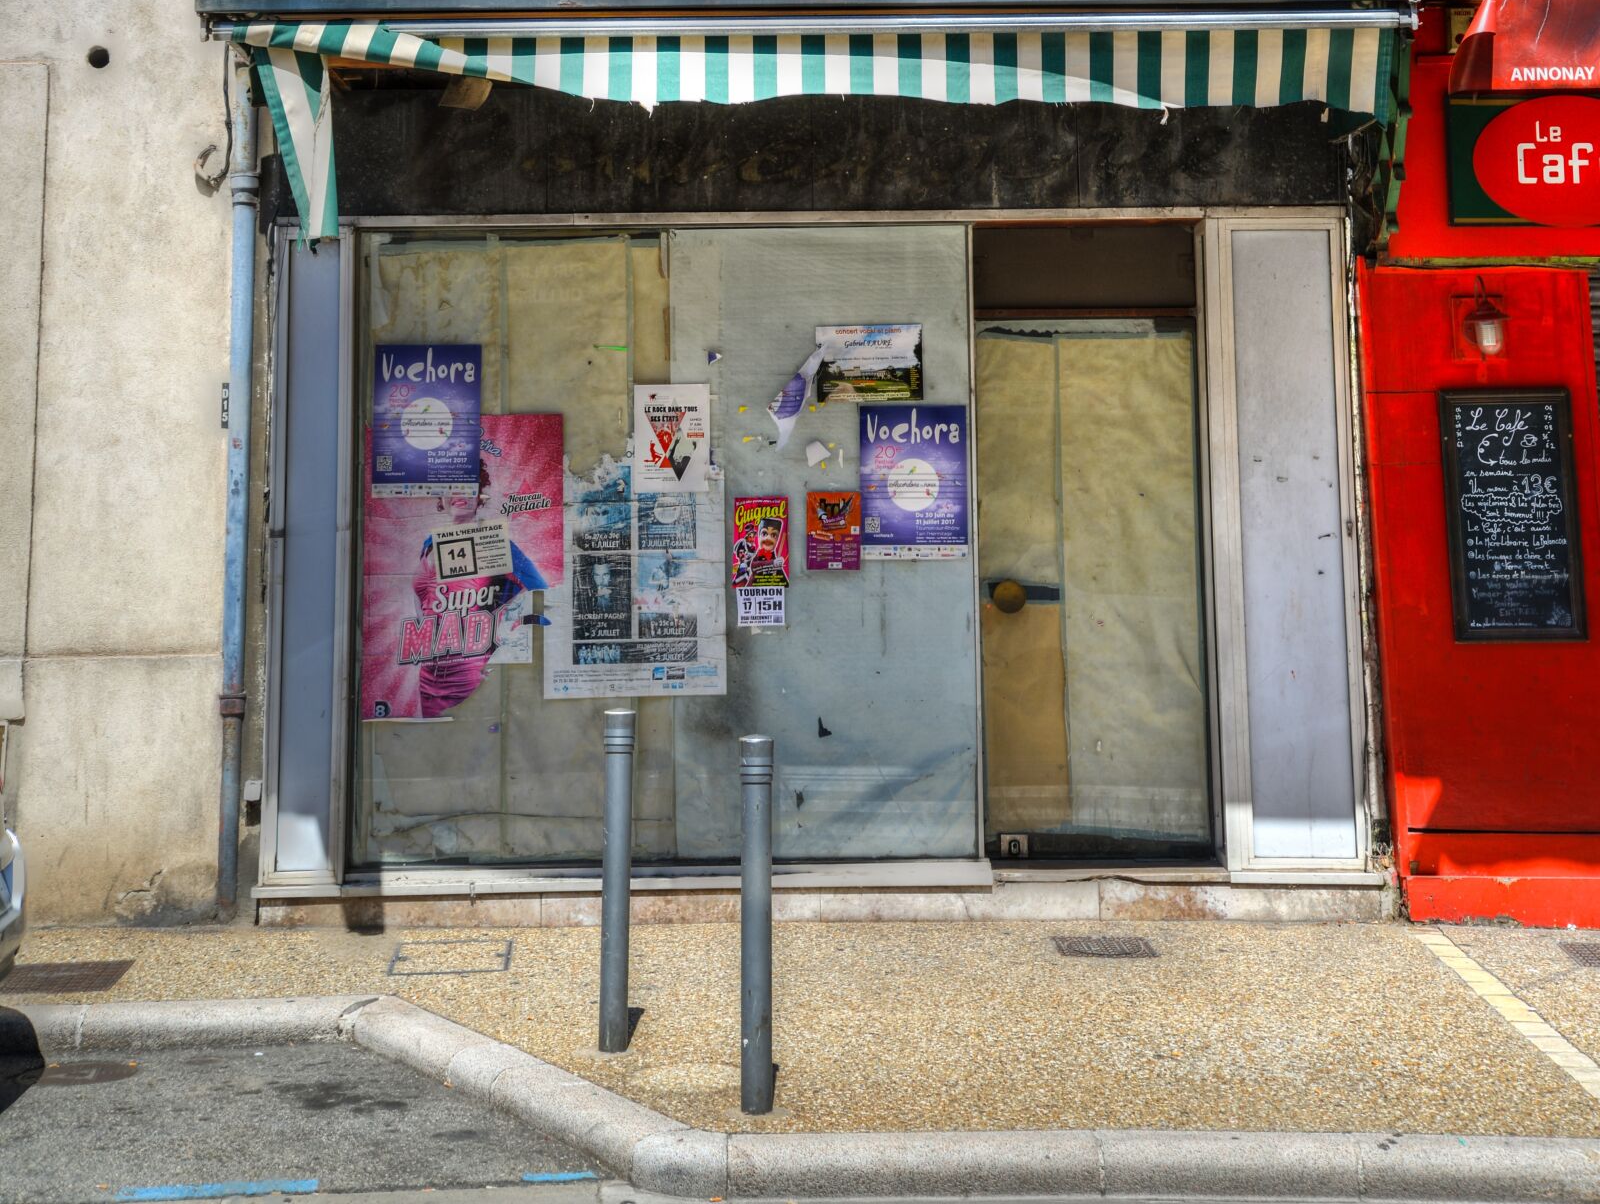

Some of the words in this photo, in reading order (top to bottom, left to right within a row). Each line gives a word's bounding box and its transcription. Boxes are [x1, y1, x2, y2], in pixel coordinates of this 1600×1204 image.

[1511, 66, 1595, 81] ANNONAY
[1536, 120, 1561, 142] Le
[1517, 143, 1600, 184] Caf
[844, 340, 866, 348] Gabriel
[866, 338, 893, 347] FAURÉ
[382, 347, 476, 384] Vochora
[867, 408, 960, 444] Vochora
[1465, 407, 1488, 430] Le
[1495, 408, 1532, 446] Café
[1499, 449, 1517, 466] tous
[1480, 468, 1514, 476] semaine
[1469, 478, 1484, 494] Un
[1512, 480, 1519, 491] à
[1522, 474, 1557, 494] 13€
[508, 493, 544, 504] Nouveau
[500, 498, 552, 516] Spectacle
[1504, 508, 1533, 518] bienvenus
[735, 501, 787, 532] Guignol
[456, 524, 503, 536] L'HERMITAGE
[1468, 520, 1479, 531] Le
[448, 548, 466, 560] 14
[1545, 550, 1556, 560] de
[450, 565, 468, 574] MAI
[738, 588, 782, 596] TOURNON
[432, 584, 500, 618] Super
[742, 602, 752, 610] 17
[757, 601, 782, 610] 15H
